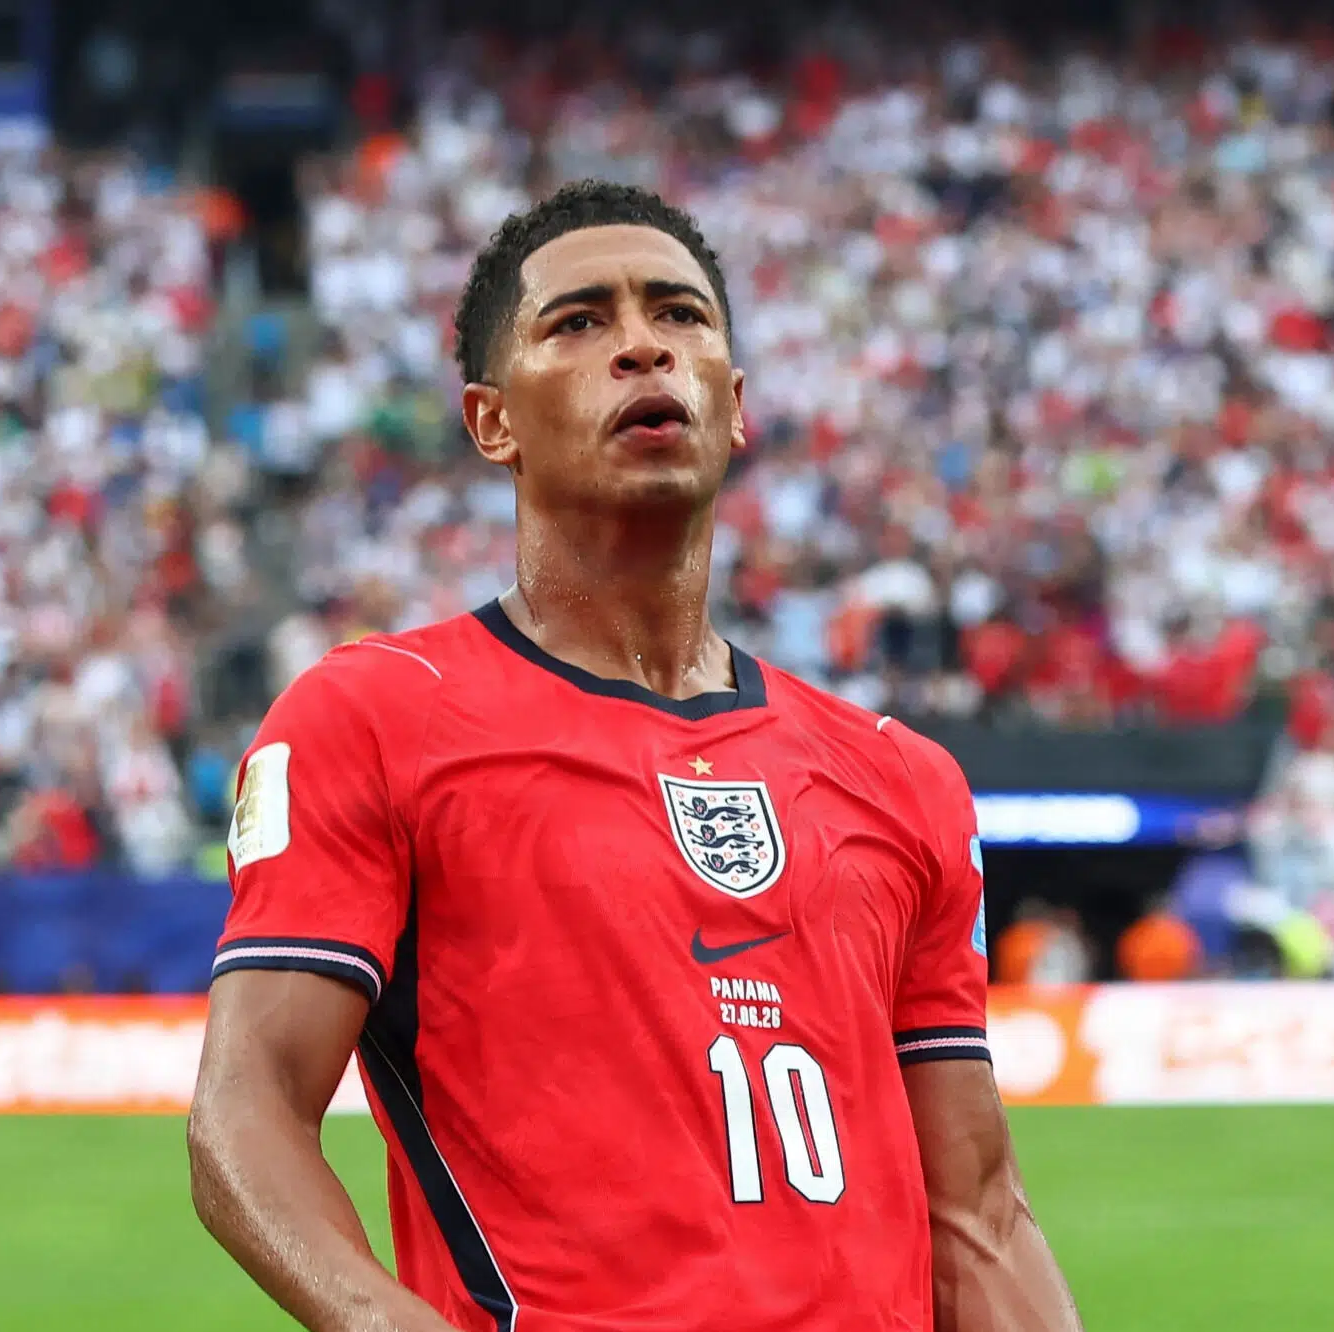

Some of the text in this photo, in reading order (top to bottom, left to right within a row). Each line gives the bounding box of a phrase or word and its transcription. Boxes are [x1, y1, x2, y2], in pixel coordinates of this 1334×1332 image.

[710, 976, 782, 1004] PANAMA
[719, 1002, 781, 1029] 27.06.26
[707, 1034, 847, 1205] 10
